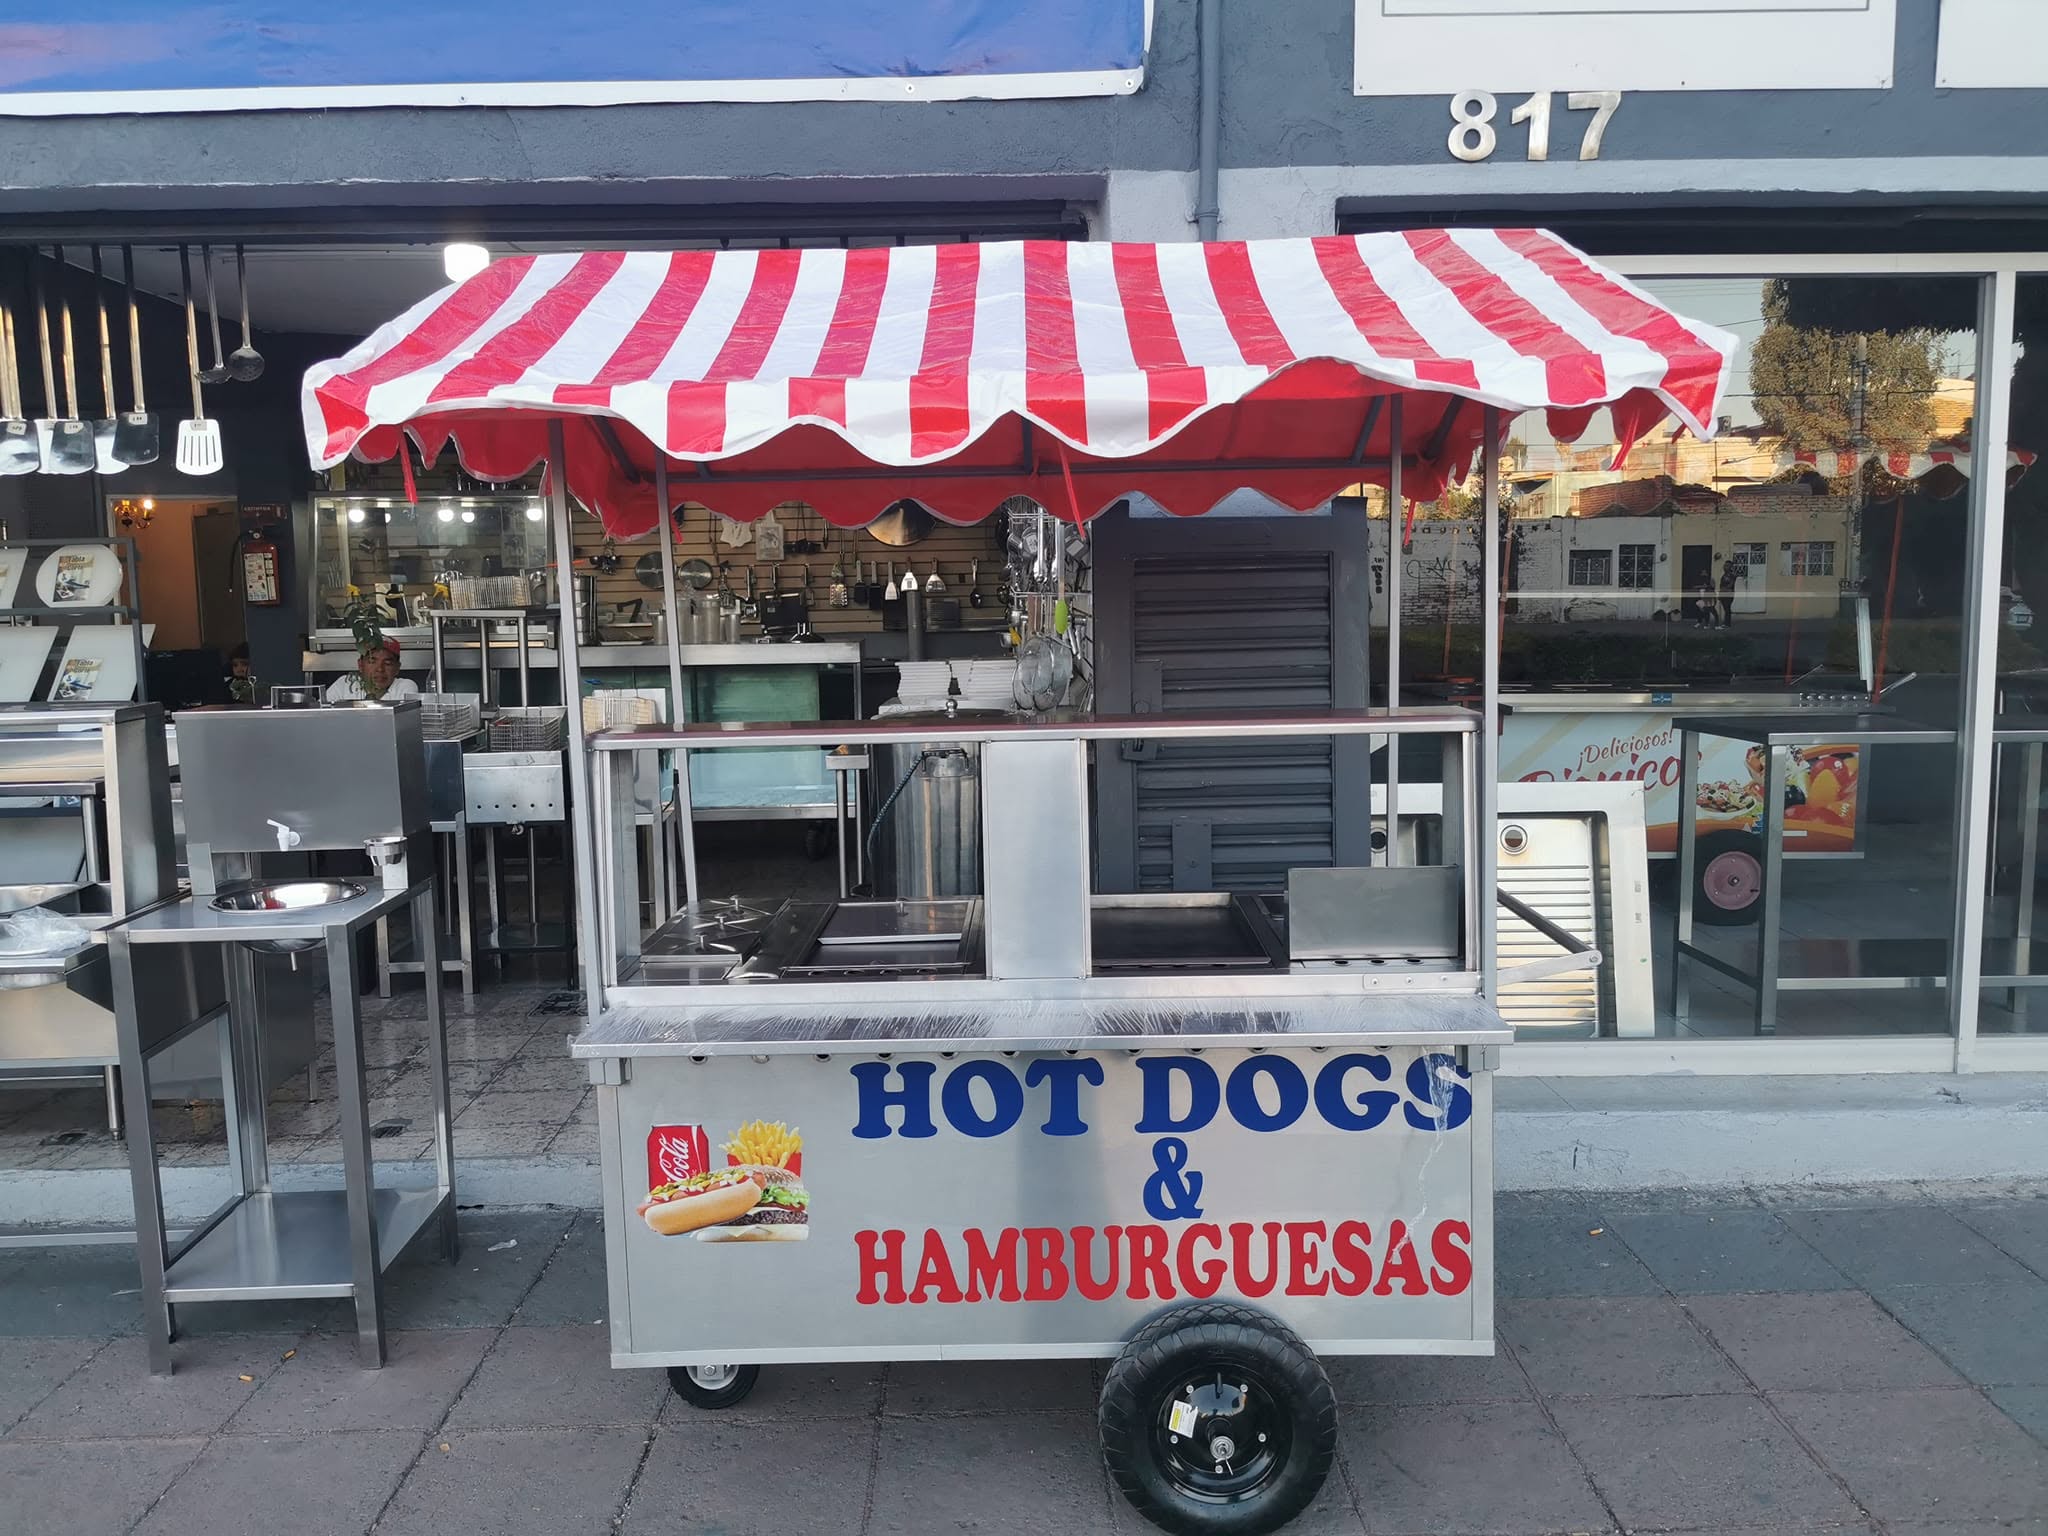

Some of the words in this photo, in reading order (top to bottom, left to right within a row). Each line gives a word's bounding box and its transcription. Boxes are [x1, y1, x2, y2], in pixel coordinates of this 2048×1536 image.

[1447, 89, 1621, 162] 817
[1577, 728, 1674, 772] ¡Deliciosos!
[850, 1057, 1105, 1139] HOT
[1135, 1054, 1473, 1133] DOGS
[1142, 1137, 1204, 1221] &
[855, 1219, 1473, 1304] HAMBURGUESAS
